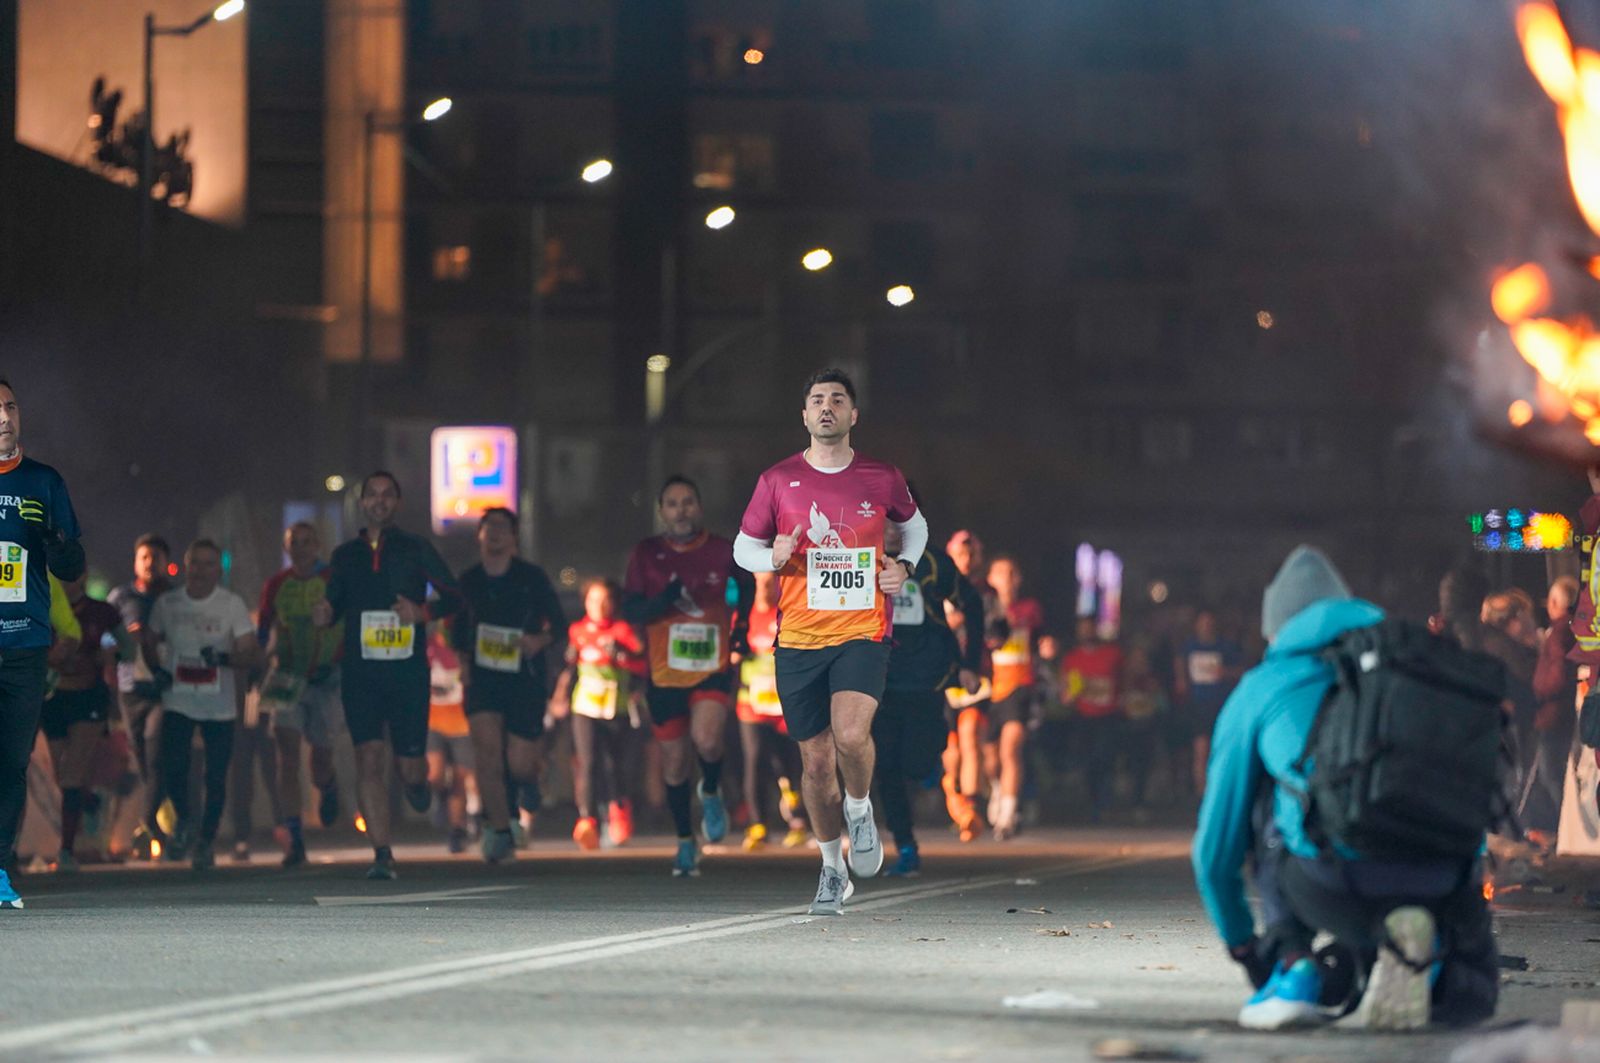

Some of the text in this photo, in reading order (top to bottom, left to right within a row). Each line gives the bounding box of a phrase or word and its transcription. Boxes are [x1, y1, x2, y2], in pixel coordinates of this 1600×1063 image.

[0, 563, 14, 582] 9
[820, 570, 865, 589] 2005
[375, 629, 402, 644] 1791
